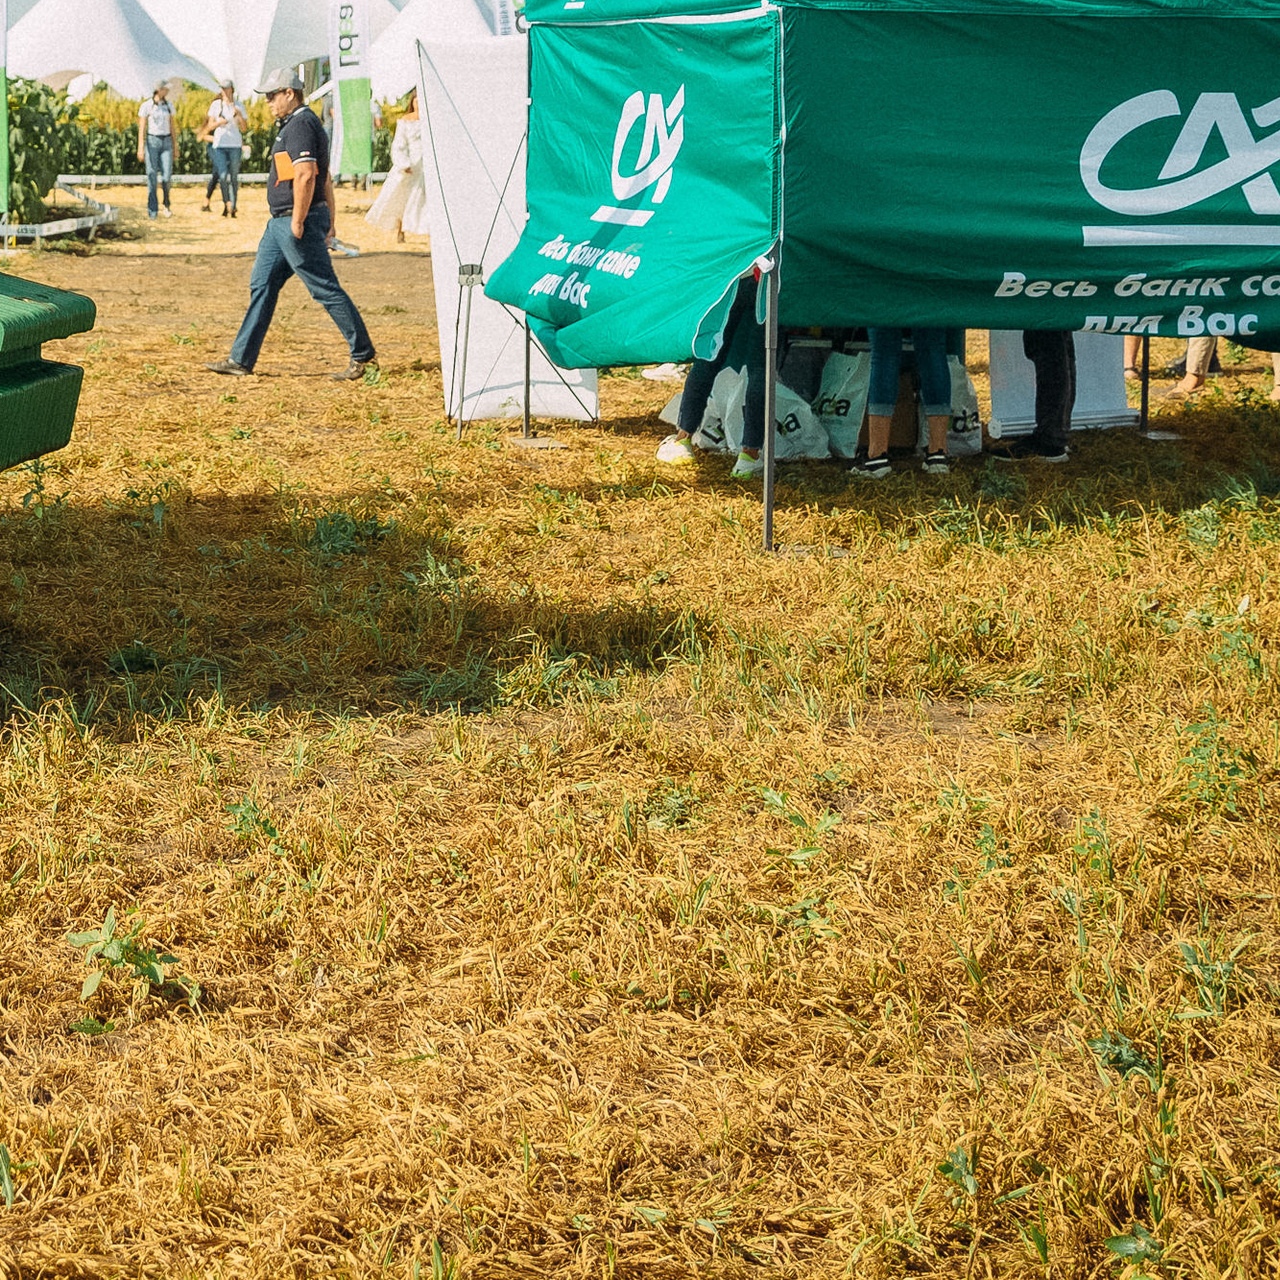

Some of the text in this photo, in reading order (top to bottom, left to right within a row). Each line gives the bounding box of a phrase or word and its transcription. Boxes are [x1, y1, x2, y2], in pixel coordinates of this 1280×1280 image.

[566, 240, 606, 268] банк
[596, 250, 651, 280] саме
[558, 271, 592, 309] Вас
[994, 272, 1098, 298] Весь
[1113, 272, 1231, 298] банк
[1177, 305, 1259, 336] Вас
